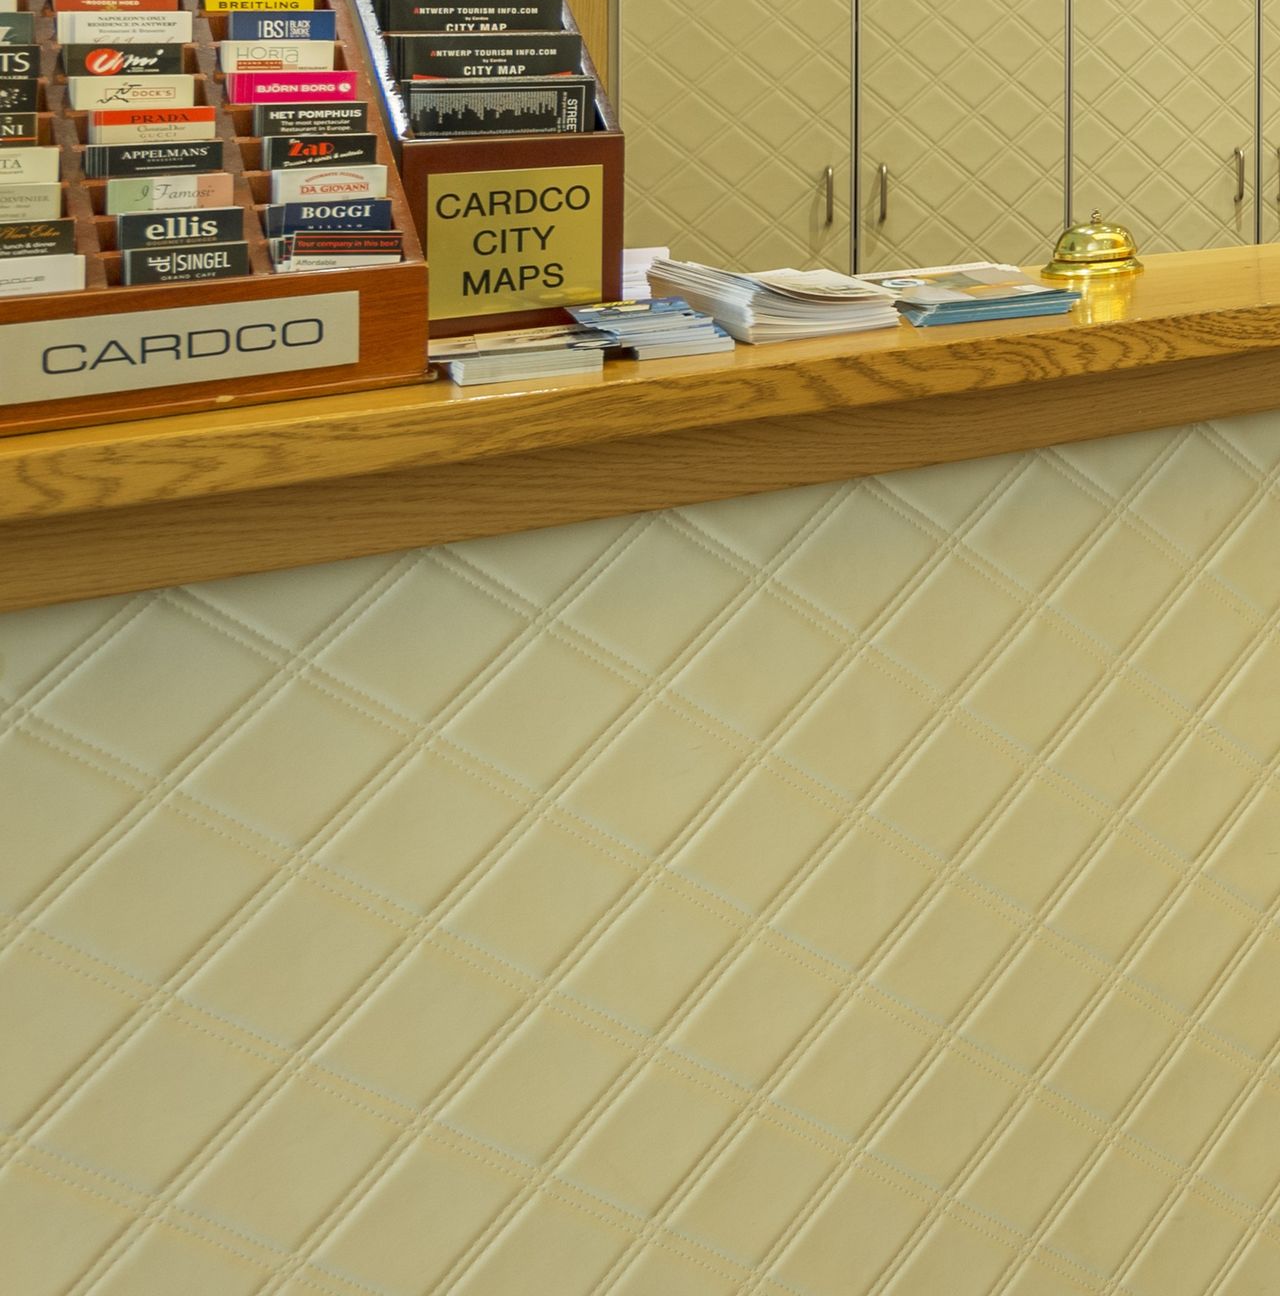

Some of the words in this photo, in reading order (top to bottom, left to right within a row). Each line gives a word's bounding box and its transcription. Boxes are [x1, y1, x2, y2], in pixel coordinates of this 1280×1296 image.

[218, 1, 300, 9] BREITLING
[413, 7, 455, 15] ANTWERP
[458, 7, 495, 15] TOURISM
[498, 7, 539, 15] INFO.COM
[263, 20, 284, 39] BS
[446, 23, 476, 32] CITY
[480, 23, 507, 32] MAP
[430, 49, 472, 58] ANTWERP
[475, 49, 514, 57] TOURISM
[516, 48, 557, 56] INFO.COM
[463, 65, 493, 76] CITY
[498, 65, 527, 75] MAP
[256, 83, 298, 93] BJÖRN
[301, 83, 335, 92] BORG
[130, 113, 190, 124] PRADA
[269, 111, 296, 120] HET
[298, 109, 362, 119] POMPHUIS
[567, 98, 578, 133] STREE
[121, 147, 208, 160] APPELMANS
[300, 185, 317, 194] DA
[320, 183, 369, 193] GIOVANNI
[435, 185, 591, 220] CARDCO
[301, 204, 371, 220] BOGGI
[145, 216, 219, 240] ellis
[473, 225, 556, 256] CITY
[176, 251, 231, 272] SINGEL
[295, 258, 337, 266] Affordable
[462, 263, 565, 297] MAPS
[41, 318, 325, 375] CARDCO
